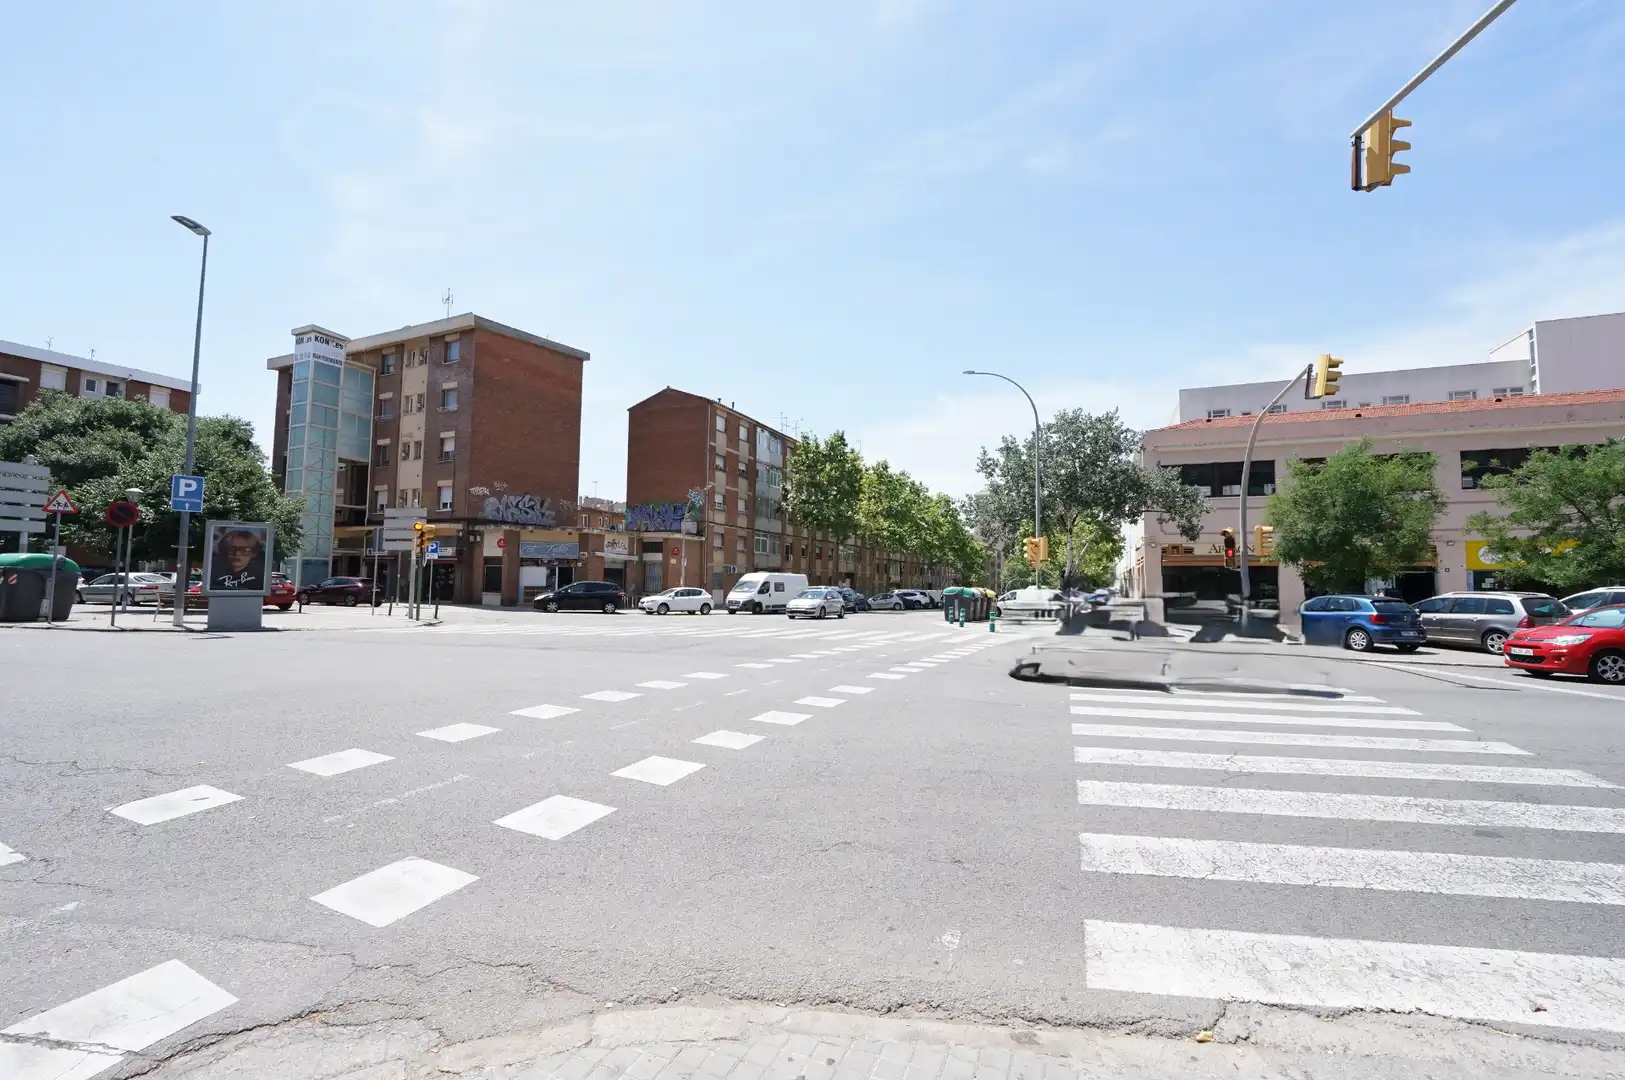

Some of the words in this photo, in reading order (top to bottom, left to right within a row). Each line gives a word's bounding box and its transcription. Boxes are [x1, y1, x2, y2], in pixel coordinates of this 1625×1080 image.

[178, 478, 198, 497] P
[428, 542, 437, 553] P
[217, 571, 256, 588] Ray-Ban
